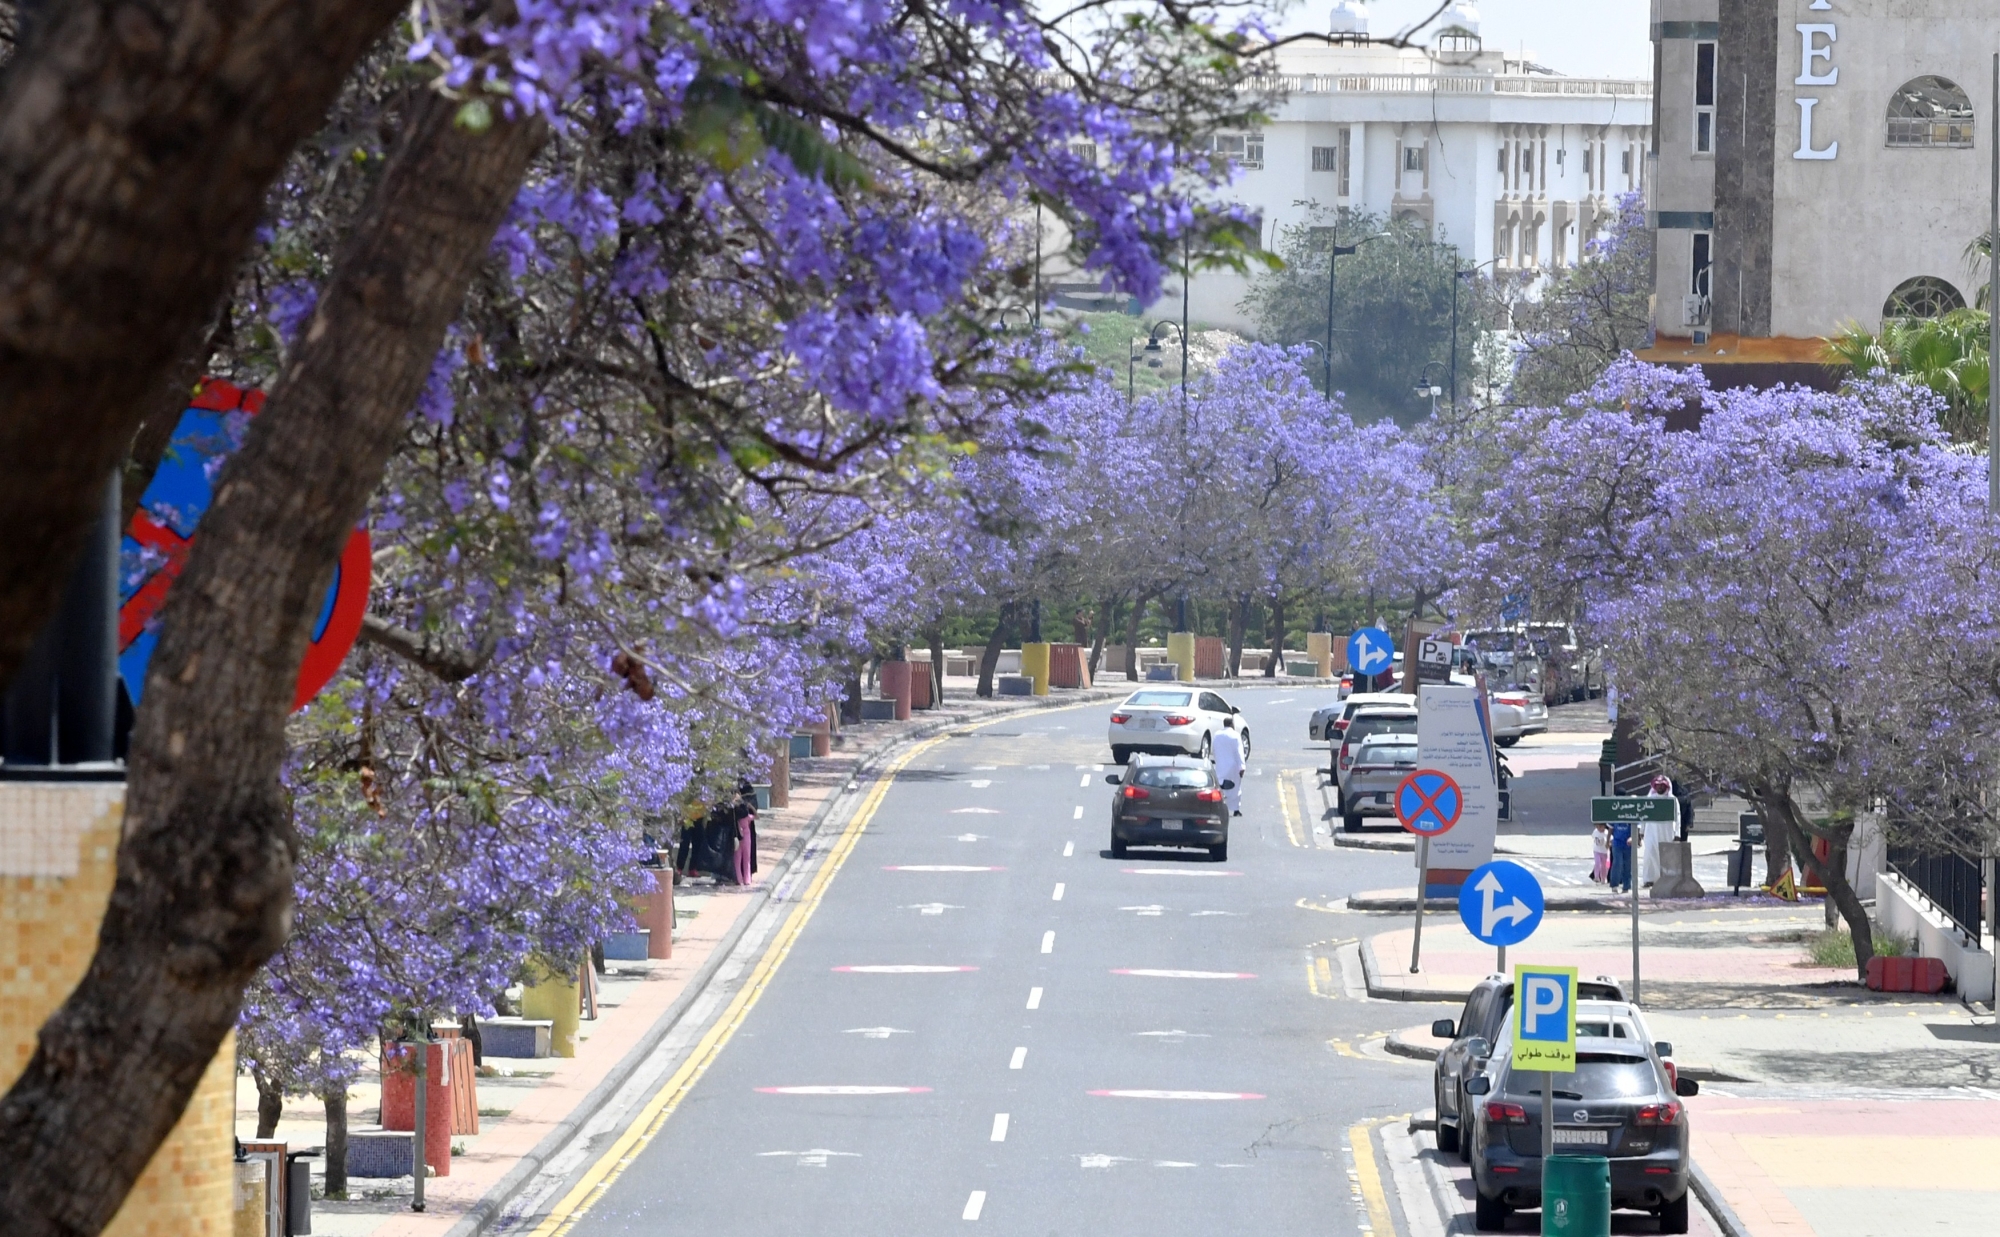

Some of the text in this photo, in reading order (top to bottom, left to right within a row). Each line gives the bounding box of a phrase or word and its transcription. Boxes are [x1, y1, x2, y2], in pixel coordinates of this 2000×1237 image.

[1793, 0, 1839, 160] EL
[1422, 641, 1438, 660] P
[1611, 801, 1655, 812] شارع حمران
[1525, 977, 1564, 1034] P
[1517, 1047, 1571, 1061] موقف طولي
